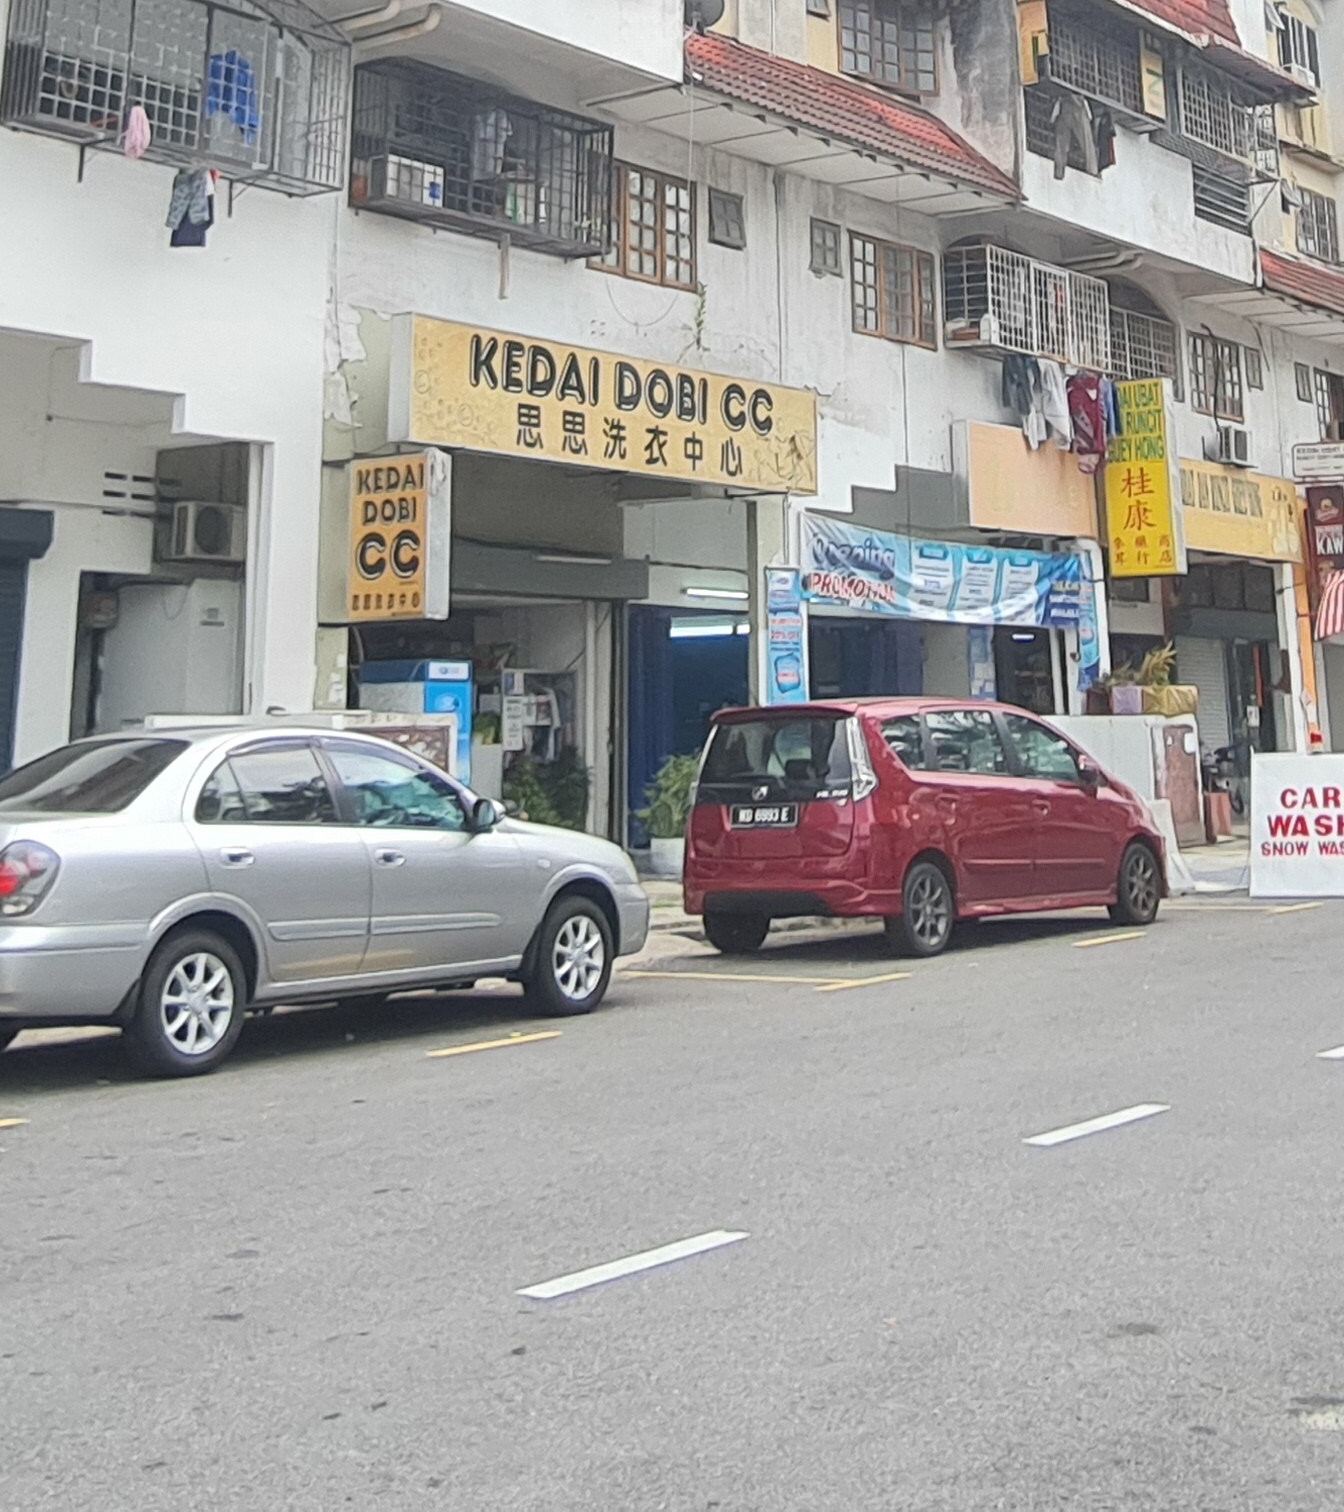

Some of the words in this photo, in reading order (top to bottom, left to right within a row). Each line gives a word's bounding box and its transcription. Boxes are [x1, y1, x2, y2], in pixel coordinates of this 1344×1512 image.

[470, 334, 600, 407] KEDAI
[614, 361, 708, 425] DOBI
[719, 383, 775, 437] CC
[516, 402, 744, 478] 思思洗衣中心
[356, 462, 425, 496] KEDAI
[1120, 466, 1157, 531] 桂康
[362, 497, 417, 526] DOBI
[355, 529, 421, 581] CC
[1280, 787, 1342, 809] CAR
[1261, 841, 1309, 857] SNOW
